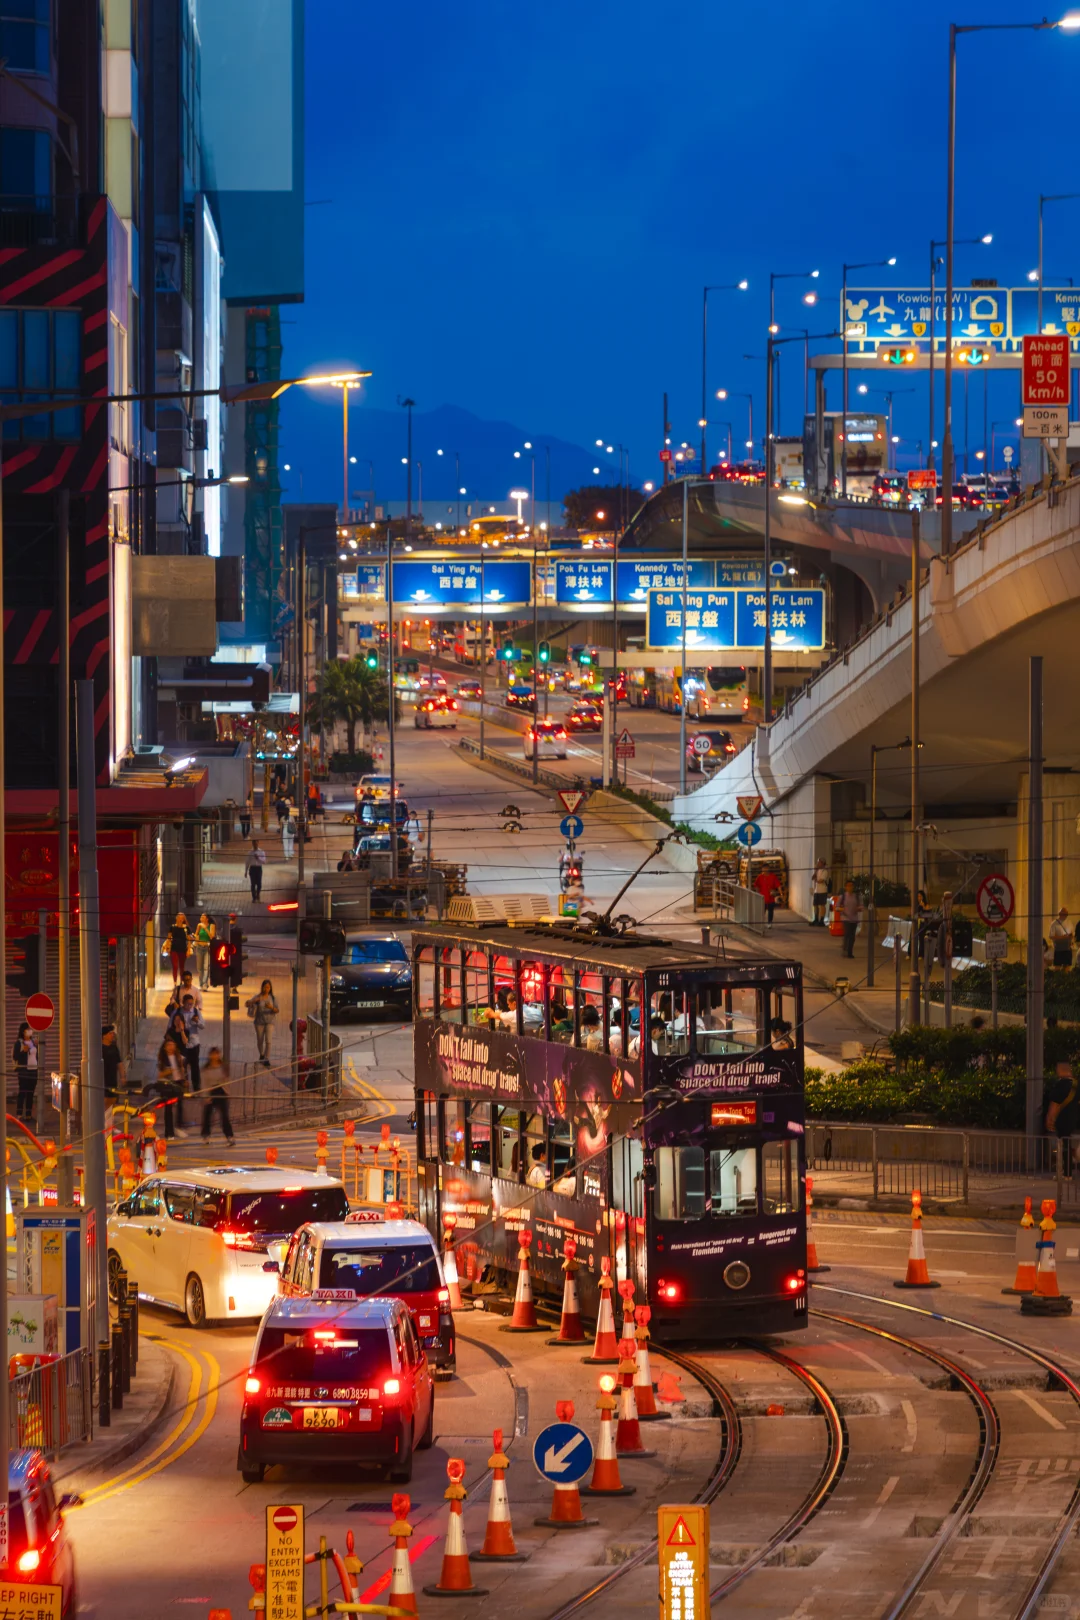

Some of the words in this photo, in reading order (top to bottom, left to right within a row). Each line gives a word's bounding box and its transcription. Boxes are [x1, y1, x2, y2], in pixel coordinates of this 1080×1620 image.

[1061, 307, 1080, 322] 堅
[916, 323, 923, 334] 3
[993, 323, 1000, 334] 3
[1070, 324, 1077, 335] 4
[1029, 341, 1064, 351] Ahead
[1031, 353, 1063, 367] 前面
[1036, 370, 1057, 384] 50
[1028, 385, 1064, 399] km/h
[1032, 411, 1058, 419] 100m
[1028, 423, 1063, 434] 一百米
[432, 565, 444, 573] Sai
[449, 565, 465, 575] Ying
[559, 564, 574, 573] Pok
[578, 564, 588, 573] Fu
[592, 564, 608, 573] Lam
[635, 564, 668, 574] Kennedy
[439, 576, 477, 589] 西營盤
[565, 575, 603, 588] 薄扶林
[639, 575, 689, 587] 堅尼地城
[656, 594, 673, 605] Sai
[708, 594, 728, 605] Pun
[746, 594, 766, 606] Pok
[772, 594, 785, 606] Fu
[790, 594, 813, 606] Lam
[666, 610, 719, 627] 西營盤
[753, 610, 806, 628] 薄扶林
[696, 740, 710, 749] 50
[439, 1034, 460, 1057] DON'T
[460, 1039, 473, 1060] fall
[473, 1042, 489, 1064] into
[693, 1063, 723, 1077] DON'T
[726, 1062, 743, 1075] fall
[745, 1062, 765, 1074] into
[472, 1068, 481, 1085] oil
[499, 1072, 520, 1093] traps!
[712, 1075, 726, 1088] oil
[755, 1072, 781, 1085] traps!
[351, 1213, 380, 1222] TAXI
[316, 1290, 353, 1299] TAXI
[306, 1418, 335, 1427] 9690
[279, 1537, 293, 1545] NO
[271, 1547, 300, 1556] ENTRY
[675, 1551, 688, 1561] NO
[269, 1558, 301, 1567] EXCEPT
[670, 1560, 694, 1570] ENTRY
[270, 1569, 300, 1577] TRAMS
[668, 1569, 695, 1578] EXCEPT
[19, 1591, 55, 1605] RIGHT
